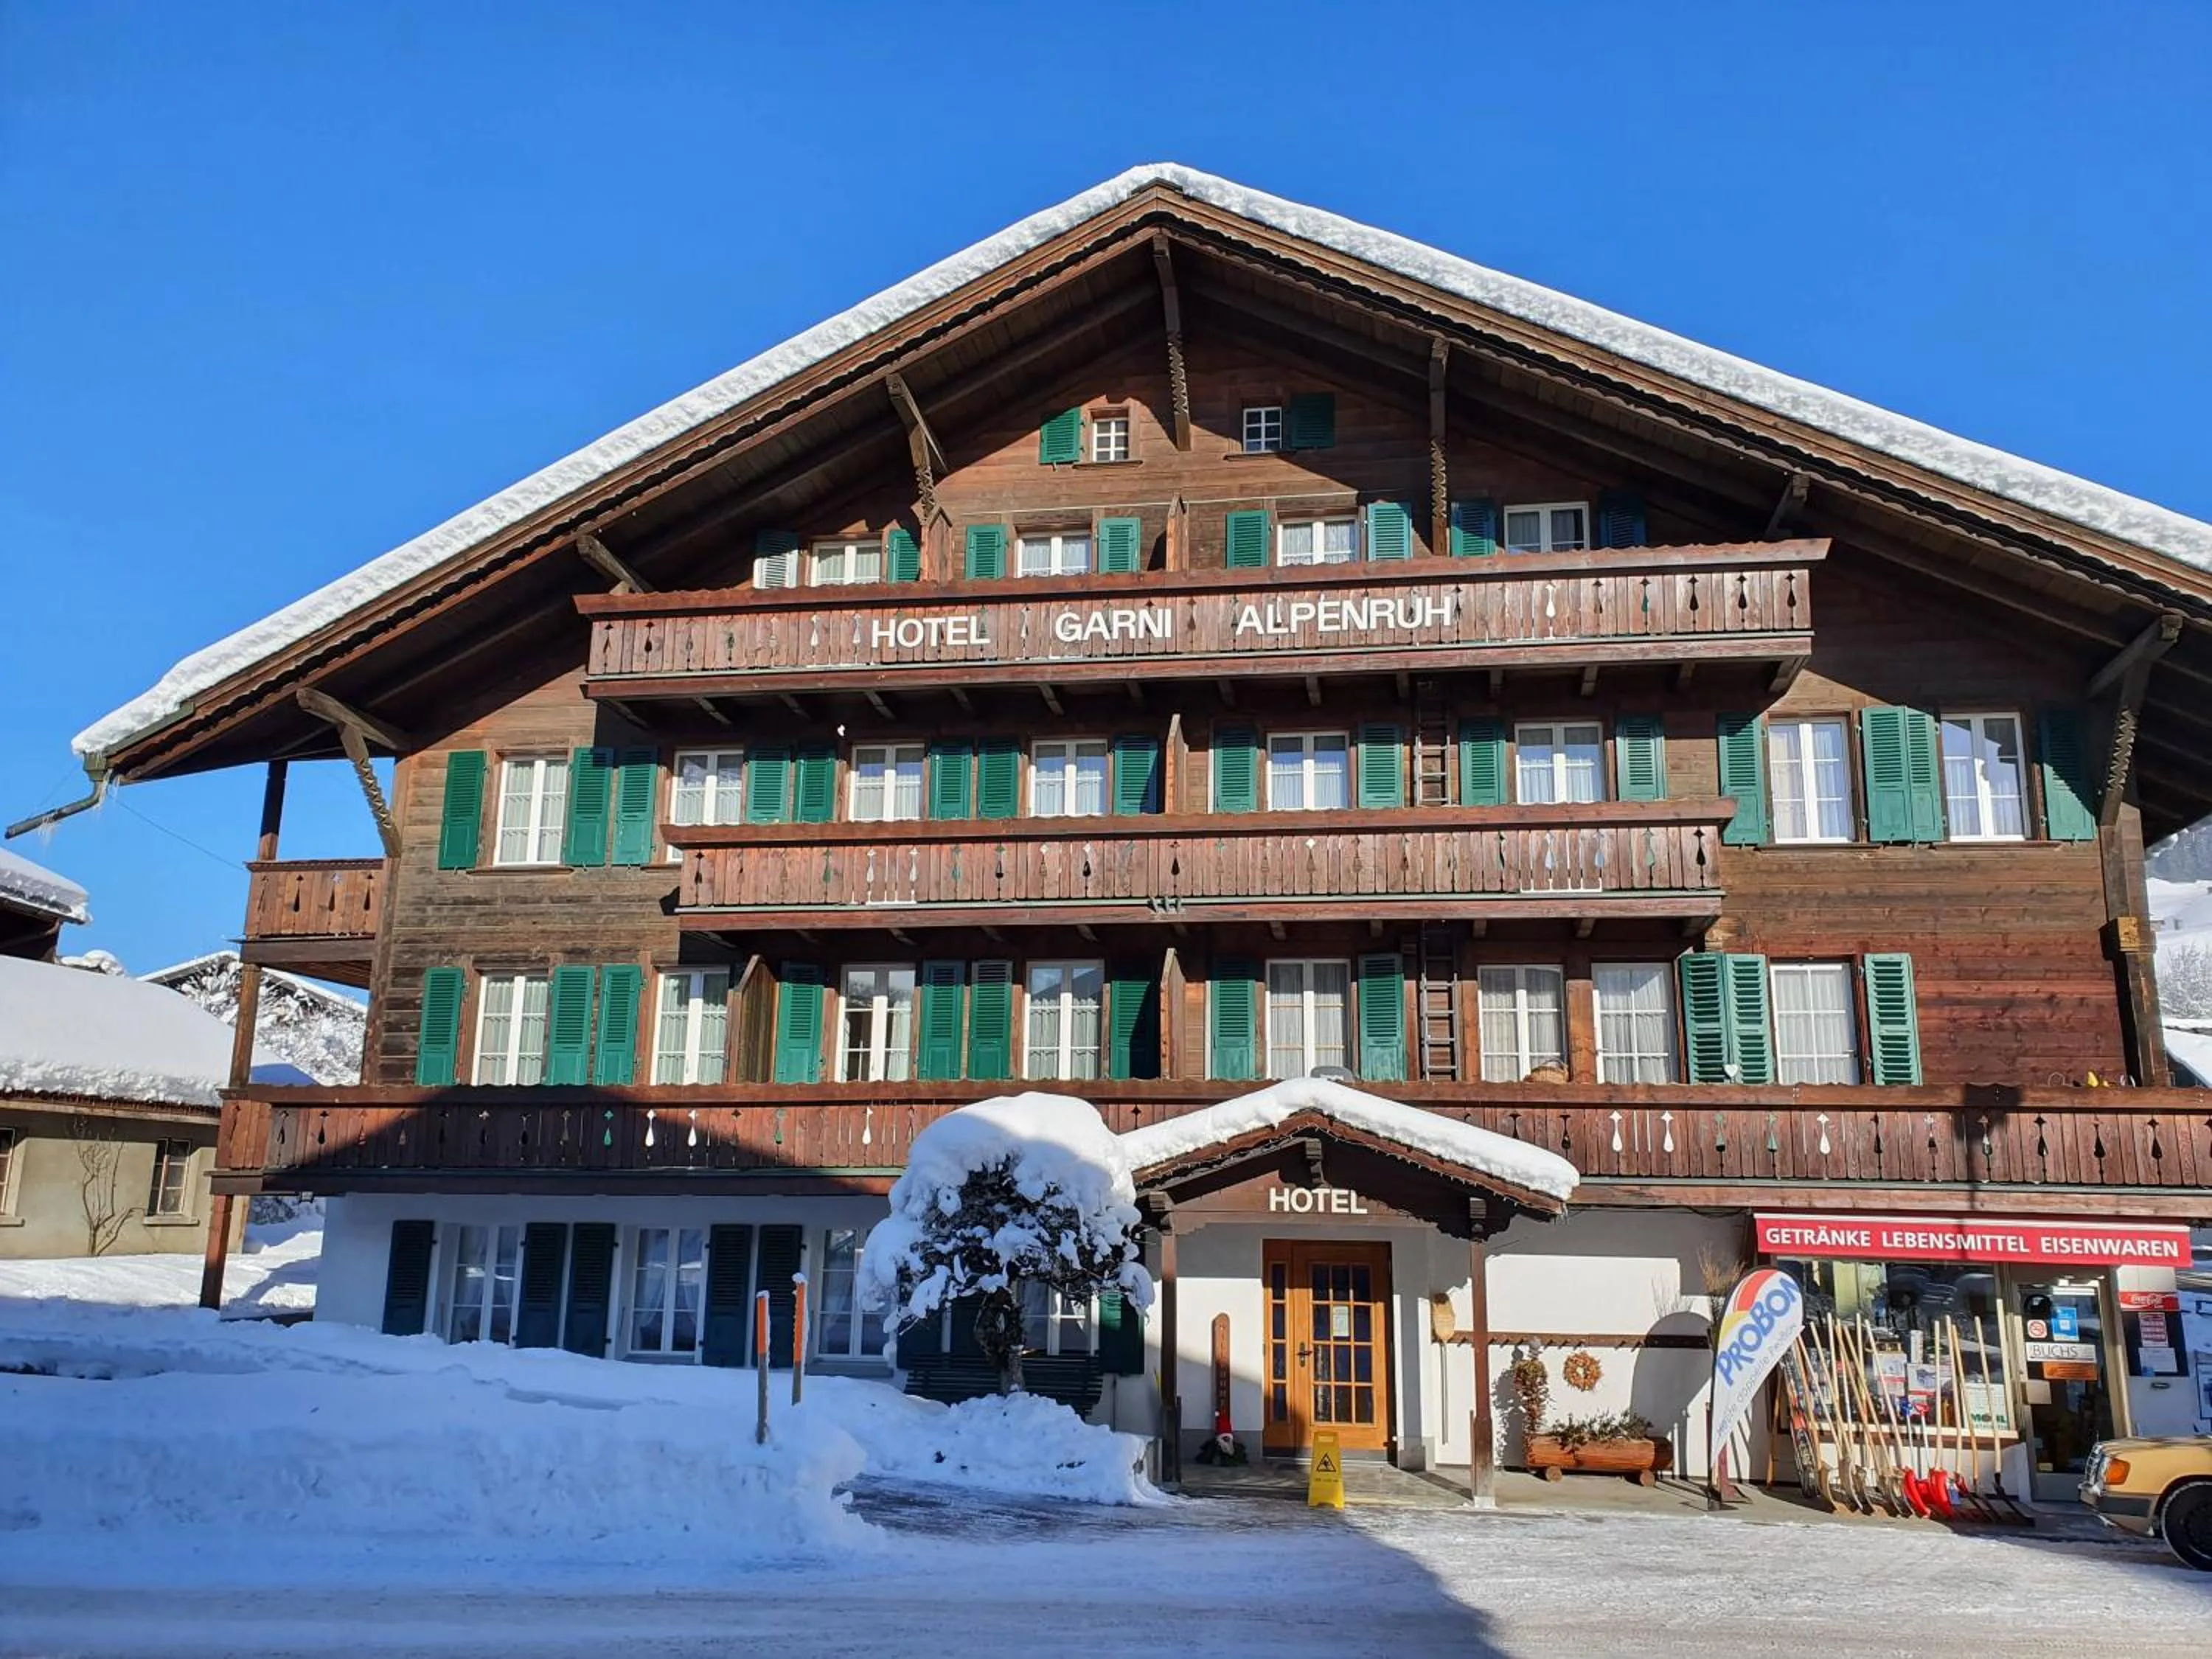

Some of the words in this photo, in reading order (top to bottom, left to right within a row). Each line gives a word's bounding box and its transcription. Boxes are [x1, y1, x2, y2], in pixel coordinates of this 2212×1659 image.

[872, 616, 990, 648] HOTEL
[1055, 608, 1172, 641] GARNI
[1236, 597, 1451, 635] ALPENRUH
[1269, 1187, 1368, 1214] HOTEL
[1765, 1226, 1871, 1246] GETRÄNKE
[1882, 1231, 2030, 1253] LEBENSMITTEL
[2040, 1237, 2179, 1257] EISENWAREN
[1717, 1277, 1800, 1388] PROBON
